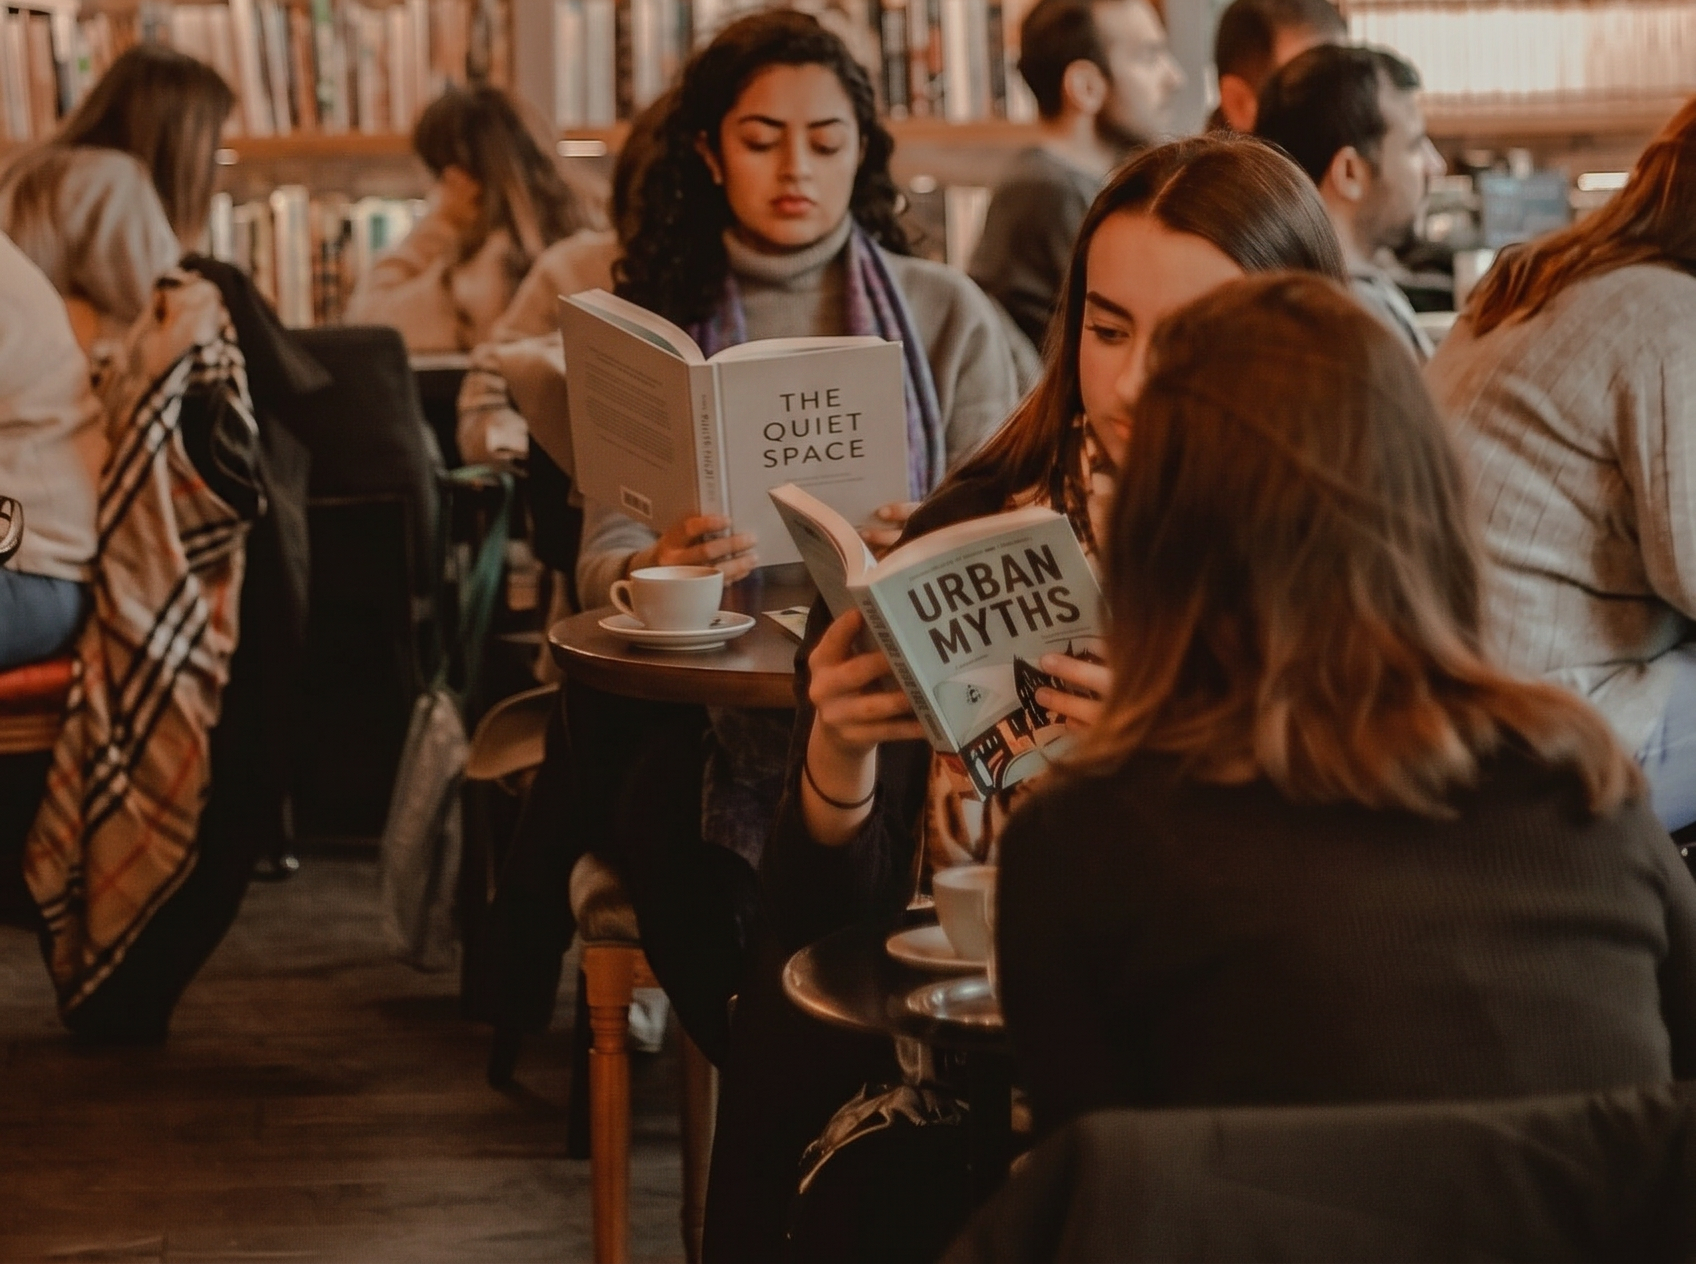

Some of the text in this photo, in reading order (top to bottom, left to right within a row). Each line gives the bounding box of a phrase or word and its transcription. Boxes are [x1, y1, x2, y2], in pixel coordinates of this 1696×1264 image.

[779, 388, 841, 412] THE
[763, 412, 862, 442] QUIET
[763, 439, 865, 468] SPACE
[907, 544, 1063, 623] URBAN
[928, 586, 1081, 664] MYTHS
